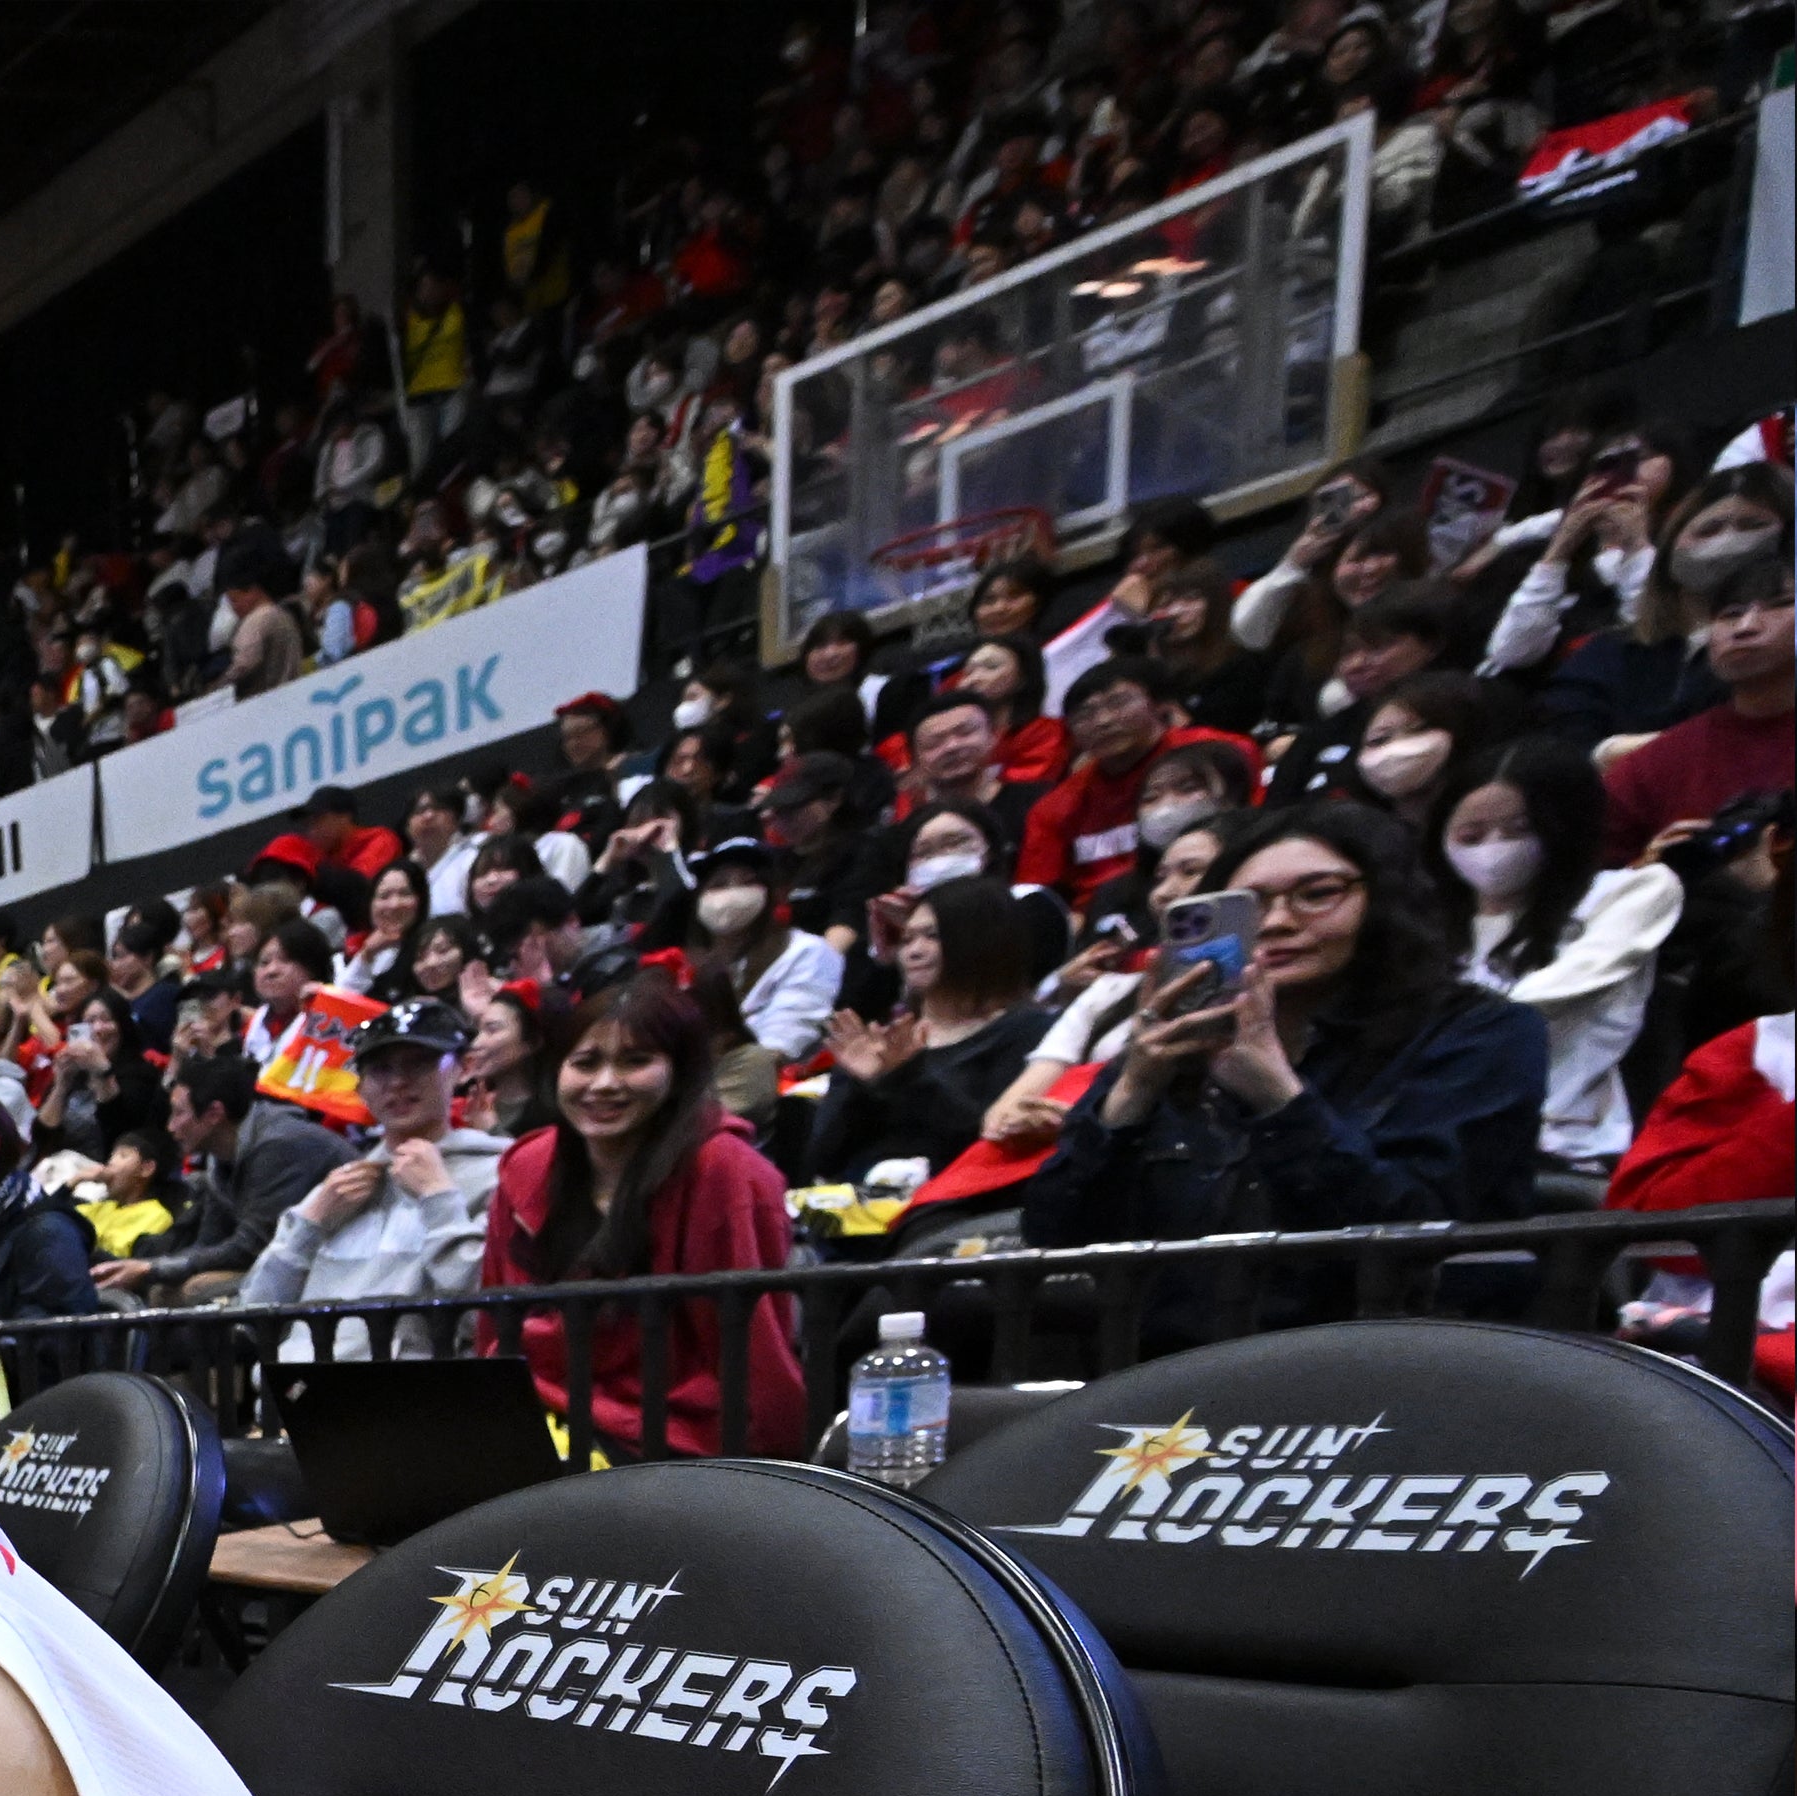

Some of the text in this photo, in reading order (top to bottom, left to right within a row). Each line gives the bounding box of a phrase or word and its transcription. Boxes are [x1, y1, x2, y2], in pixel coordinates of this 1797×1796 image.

[987, 1406, 1611, 1582] ROCKERS
[1204, 1418, 1373, 1470] SUN
[522, 1573, 661, 1636] SUN
[327, 1562, 859, 1794] ROCKERS
